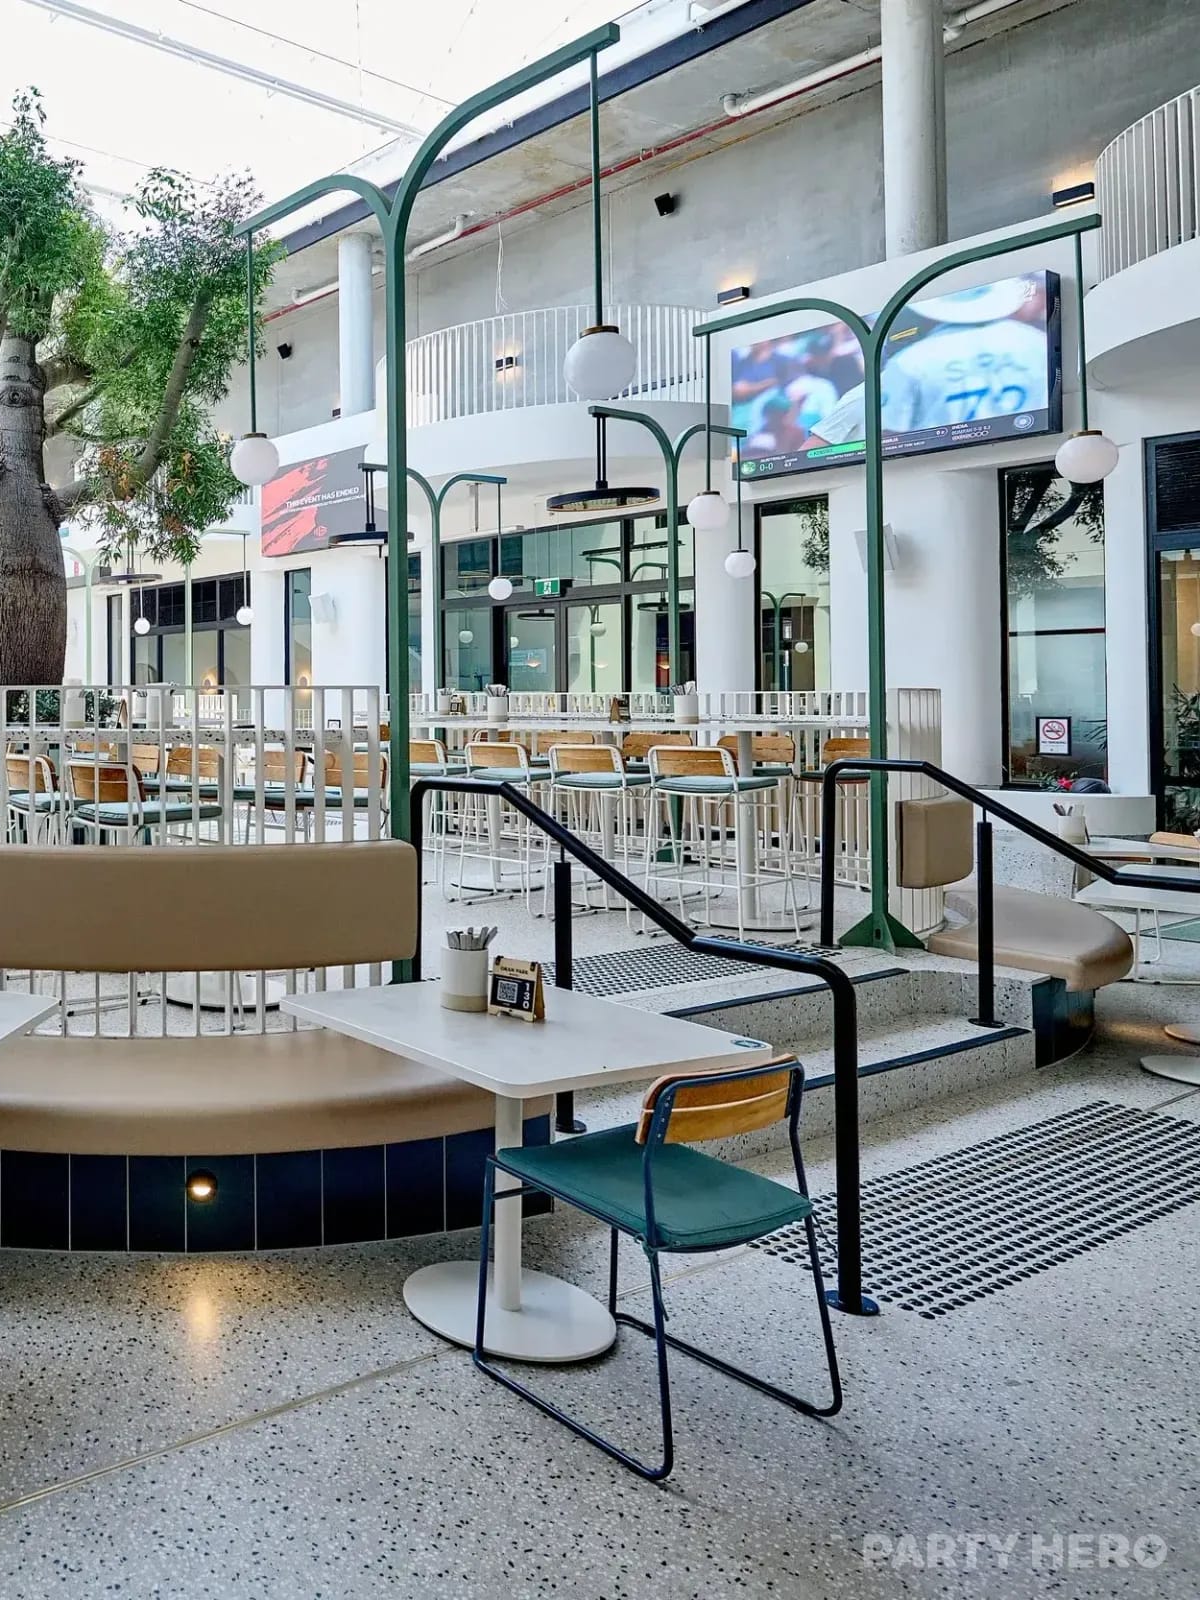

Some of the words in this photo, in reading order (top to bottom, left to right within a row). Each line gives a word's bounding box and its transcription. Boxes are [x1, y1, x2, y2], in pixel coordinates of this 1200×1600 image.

[760, 462, 774, 472] 0-0
[286, 500, 300, 510] THIS
[300, 494, 321, 506] EVENT
[321, 491, 336, 500] HAS
[336, 486, 360, 497] ENDED
